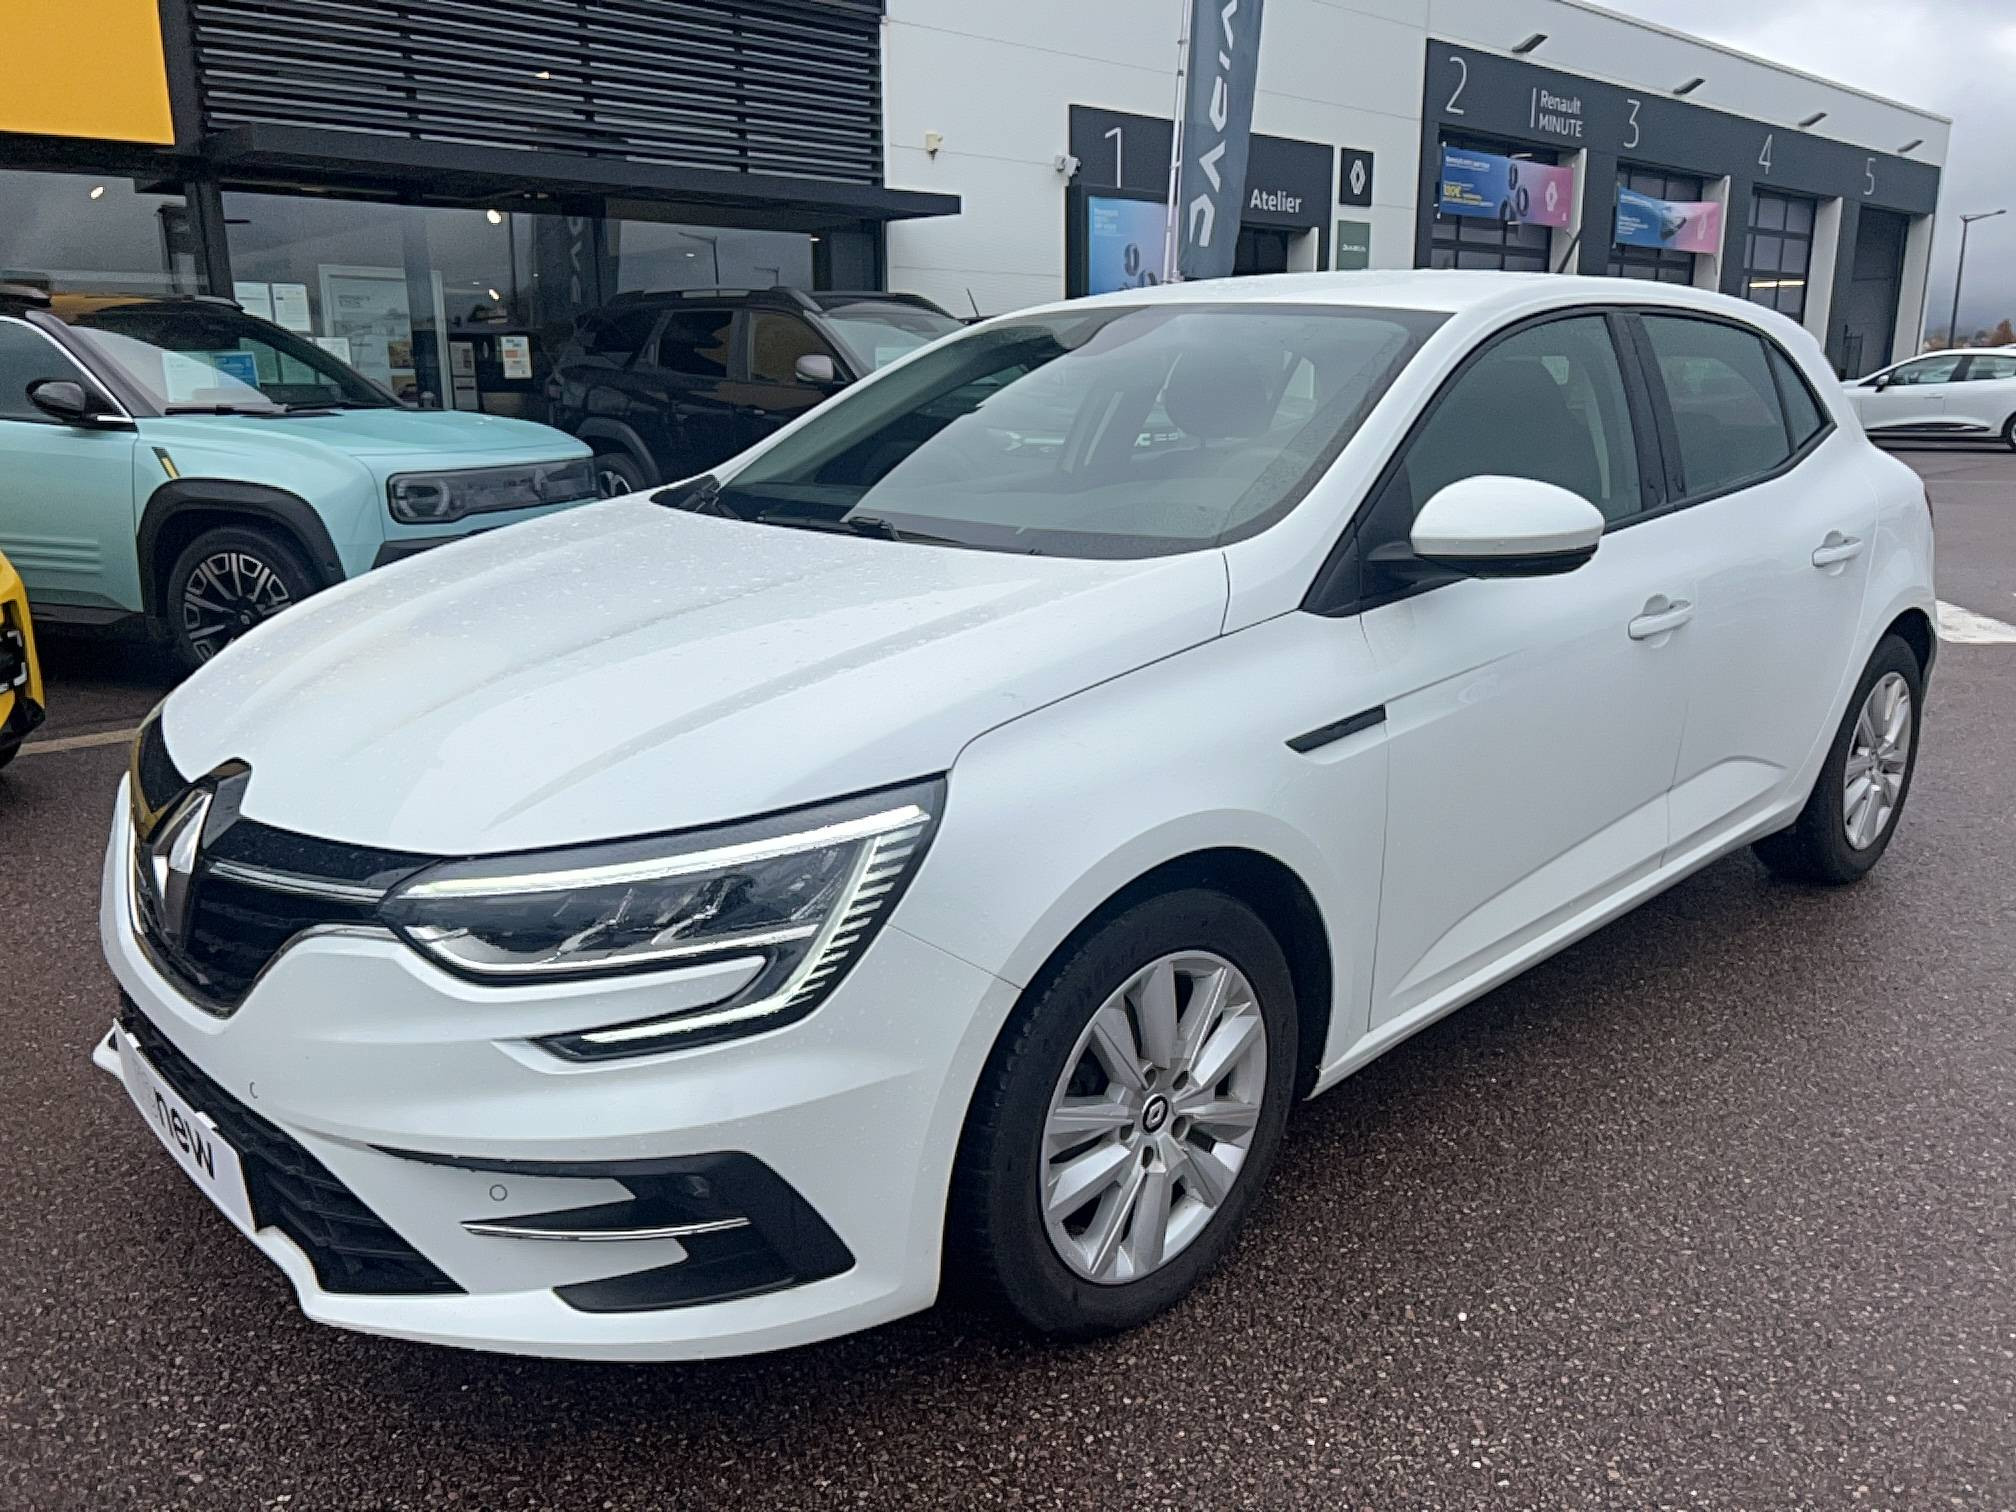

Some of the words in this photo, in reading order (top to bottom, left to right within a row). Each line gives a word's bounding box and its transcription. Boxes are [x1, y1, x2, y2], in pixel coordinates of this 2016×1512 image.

[1446, 56, 1467, 115] 2
[1540, 90, 1582, 115] Renault
[1189, 0, 1238, 248] DACIA
[1538, 113, 1584, 137] MINUTE
[1623, 99, 1640, 148] 3
[1104, 127, 1122, 189] 1
[1758, 133, 1773, 175] 4
[1863, 157, 1876, 195] 5
[1250, 188, 1302, 213] Atelier
[153, 1086, 216, 1181] new
